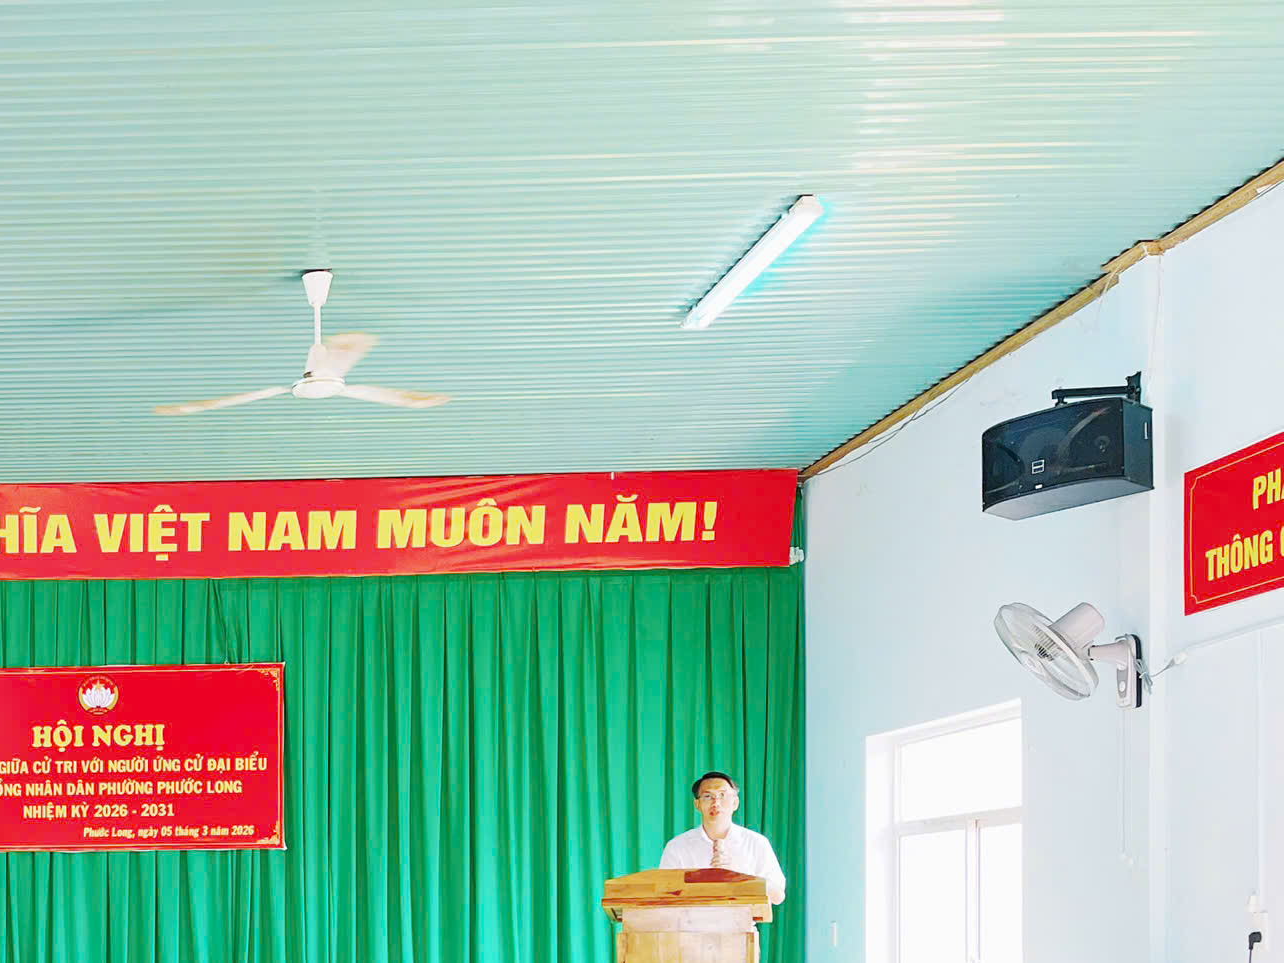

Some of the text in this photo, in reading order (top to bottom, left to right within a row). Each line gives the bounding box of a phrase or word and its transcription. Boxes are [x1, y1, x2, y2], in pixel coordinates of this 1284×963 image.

[1252, 467, 1284, 510] PH
[94, 504, 210, 561] VIỆT
[228, 510, 357, 552] NAM
[376, 498, 546, 549] MUÔN
[564, 494, 718, 543] NĂM!
[1204, 530, 1274, 582] THÔNG
[31, 719, 166, 753] HỘI NGHỊ
[32, 755, 52, 774] CỬ
[55, 760, 78, 774] TRI
[81, 756, 104, 774] VỚI
[108, 755, 149, 773] NGƯỜI
[152, 756, 181, 772] ỨNG
[184, 753, 204, 771] CỬ
[207, 757, 231, 774] ĐẠI
[235, 751, 268, 771] BIỂU
[26, 779, 63, 797] NHÂN
[66, 779, 95, 796] DÂN
[99, 778, 154, 796] PHƯỜNG
[157, 777, 203, 795] PHƯỚC
[206, 780, 243, 794] LONG
[23, 801, 67, 821] NHIỆM
[71, 801, 89, 818] KỲ
[93, 804, 129, 818] 2026
[141, 803, 175, 817] 2031
[83, 825, 255, 839] Phước Long, ngày 05 tháng 3 năm 2026
